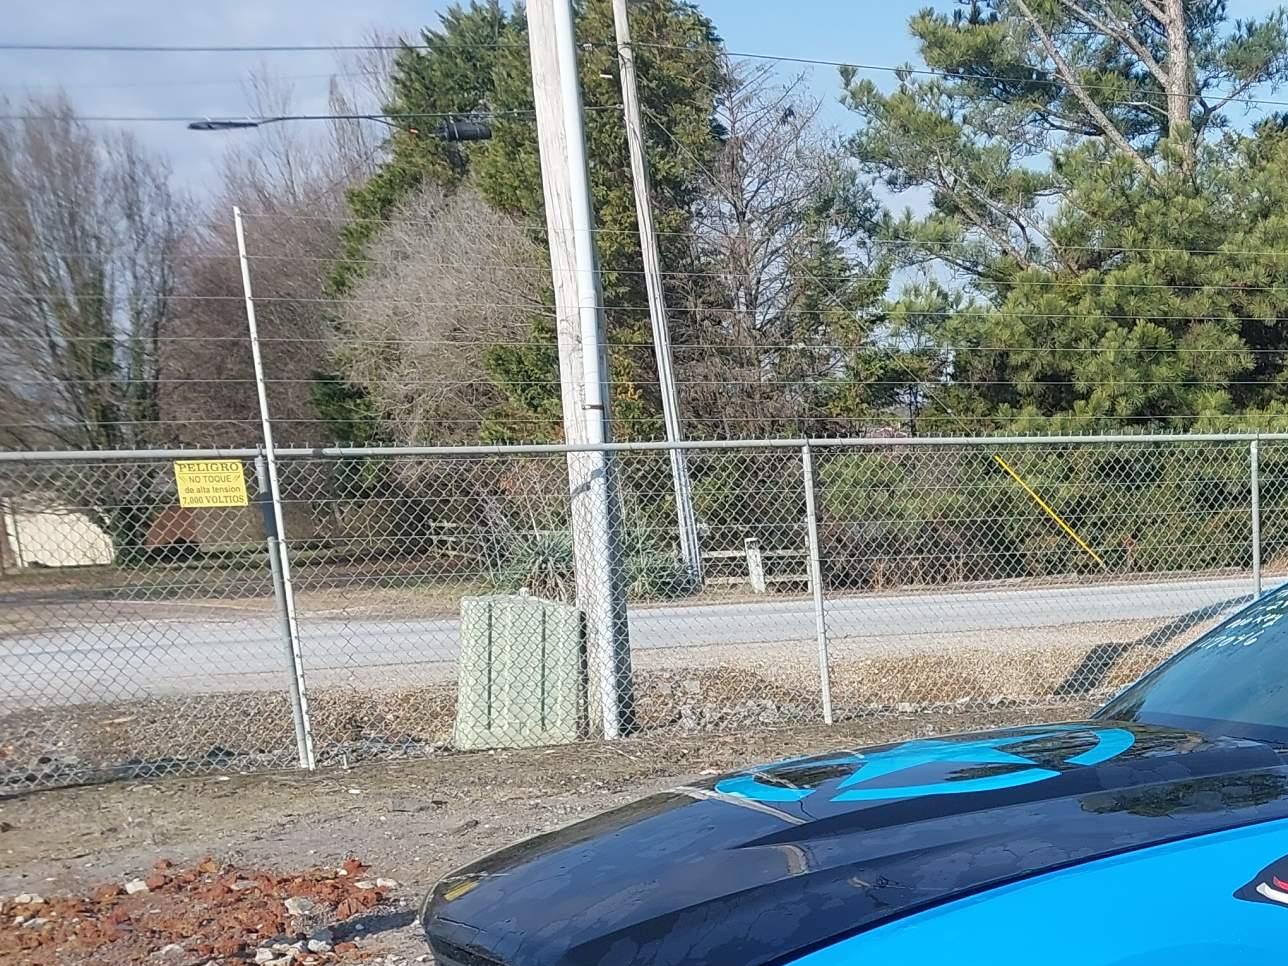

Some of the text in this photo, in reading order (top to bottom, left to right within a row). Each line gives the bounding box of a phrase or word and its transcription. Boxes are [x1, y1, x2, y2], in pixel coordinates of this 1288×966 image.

[179, 463, 239, 472] PELIGRO
[189, 475, 232, 484] NO TOQUE
[184, 486, 195, 494] de
[196, 486, 210, 494] alta
[205, 495, 244, 504] VOLTIOS
